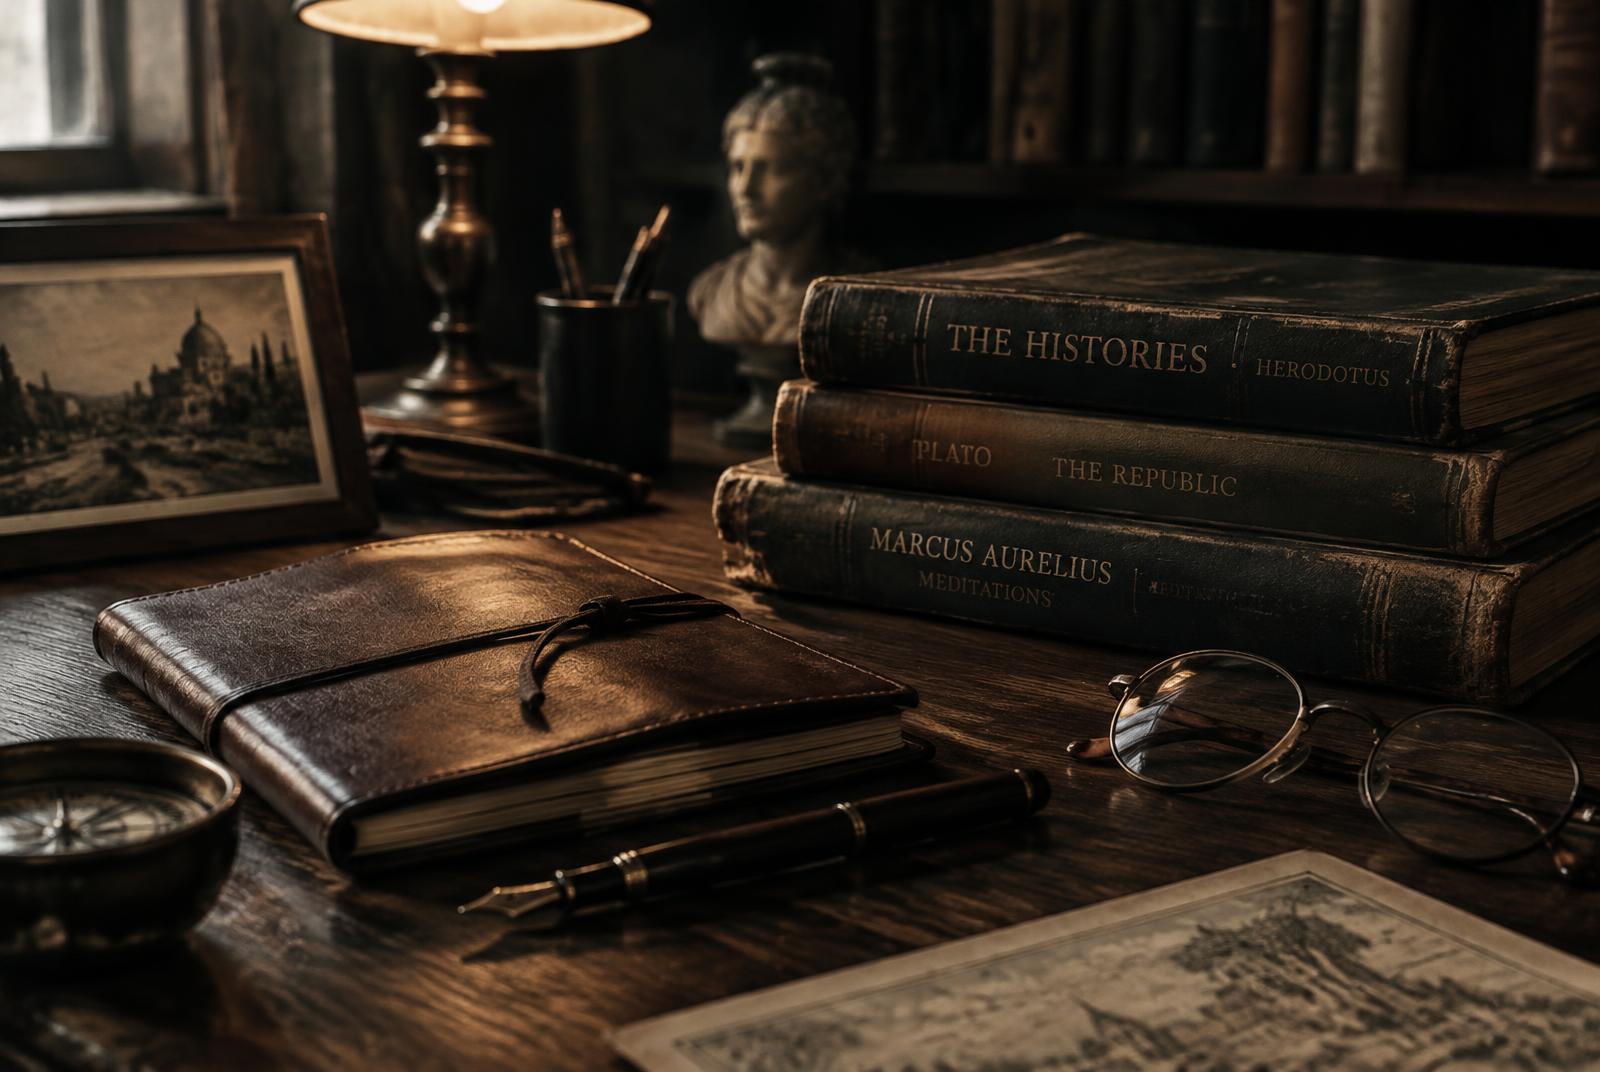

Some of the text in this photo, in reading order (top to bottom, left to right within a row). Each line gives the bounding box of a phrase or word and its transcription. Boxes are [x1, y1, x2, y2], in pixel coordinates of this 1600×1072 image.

[947, 323, 1208, 374] THE HISTORIES
[1255, 358, 1391, 388] HERODOTUS
[913, 439, 992, 468] PLATO
[1052, 456, 1238, 497] THE REPUBLIC
[869, 527, 1112, 585] MARCUS AURELIUS
[918, 570, 1052, 608] MEDITATIONS
